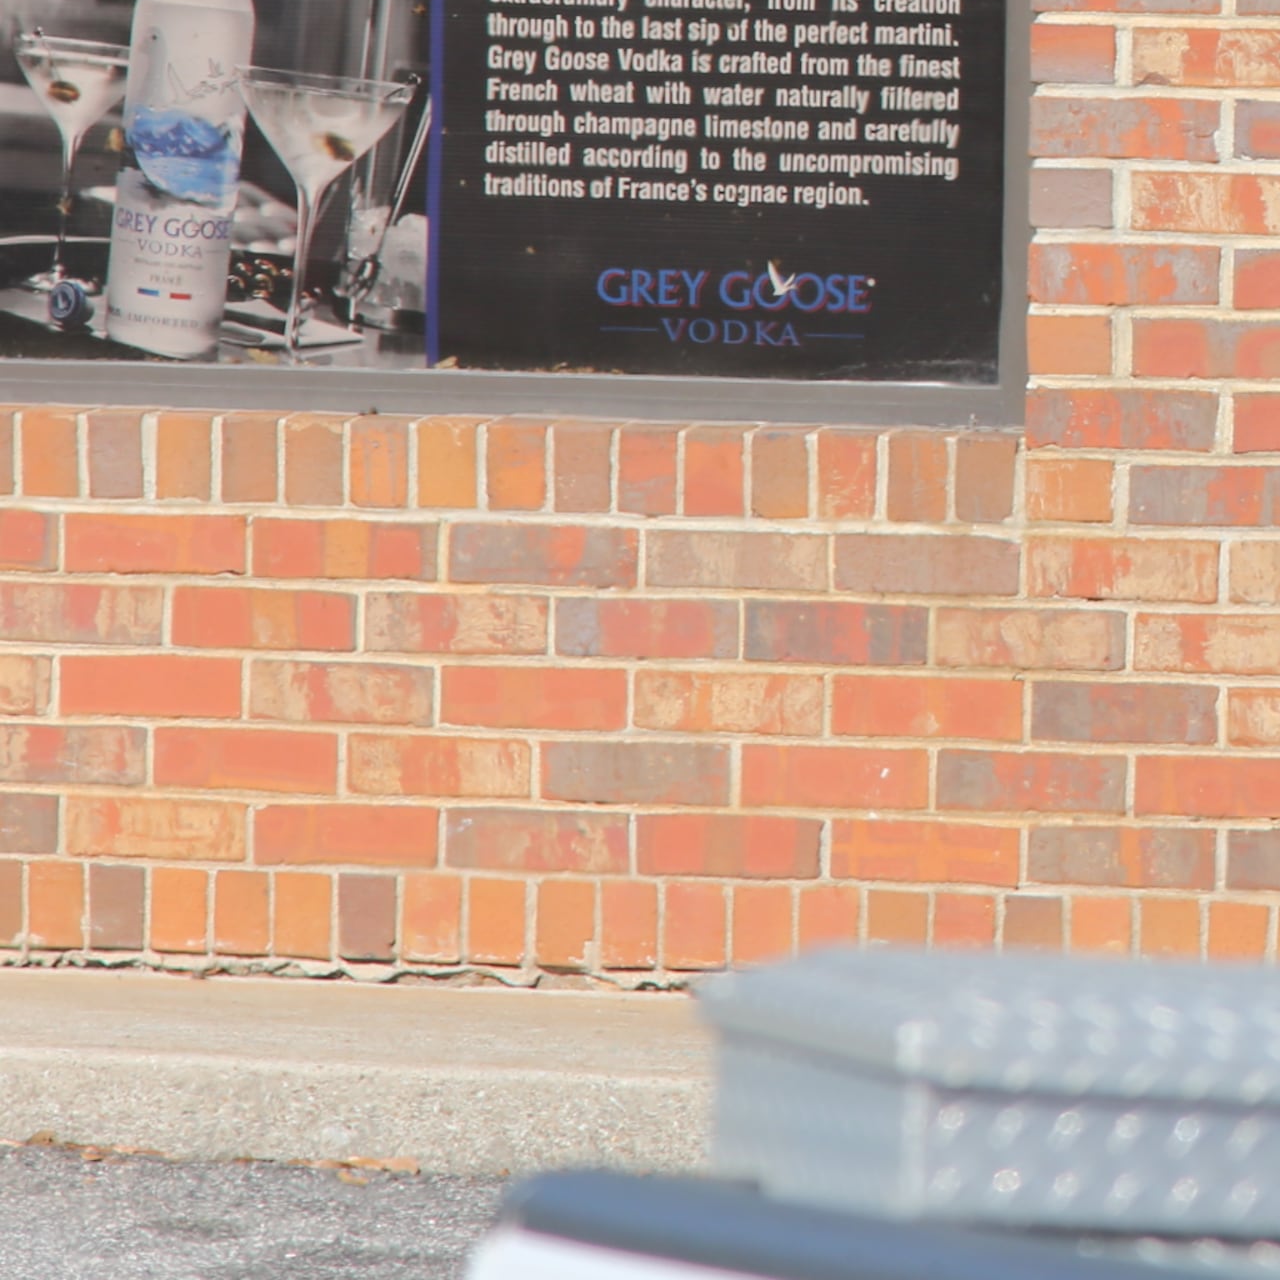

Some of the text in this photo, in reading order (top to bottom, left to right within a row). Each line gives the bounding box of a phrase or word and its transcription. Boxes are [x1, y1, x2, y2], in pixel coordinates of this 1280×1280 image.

[486, 13, 959, 49] through to the last sip of the perfect martini.
[486, 45, 961, 79] Grey Goose Vodka is crafted from the finest
[486, 77, 960, 115] French wheat with water naturally filtered
[484, 109, 960, 149] through champagne limestone and carefully
[485, 140, 959, 181] distilled according to the uncompromising
[483, 172, 585, 199] traditions
[589, 175, 613, 199] of
[713, 183, 788, 208] cognac
[793, 181, 870, 210] region.
[115, 207, 158, 234] GREY
[137, 238, 203, 258] VODKA
[596, 267, 873, 313] GREY GOOSE
[661, 317, 801, 347] VODKA
